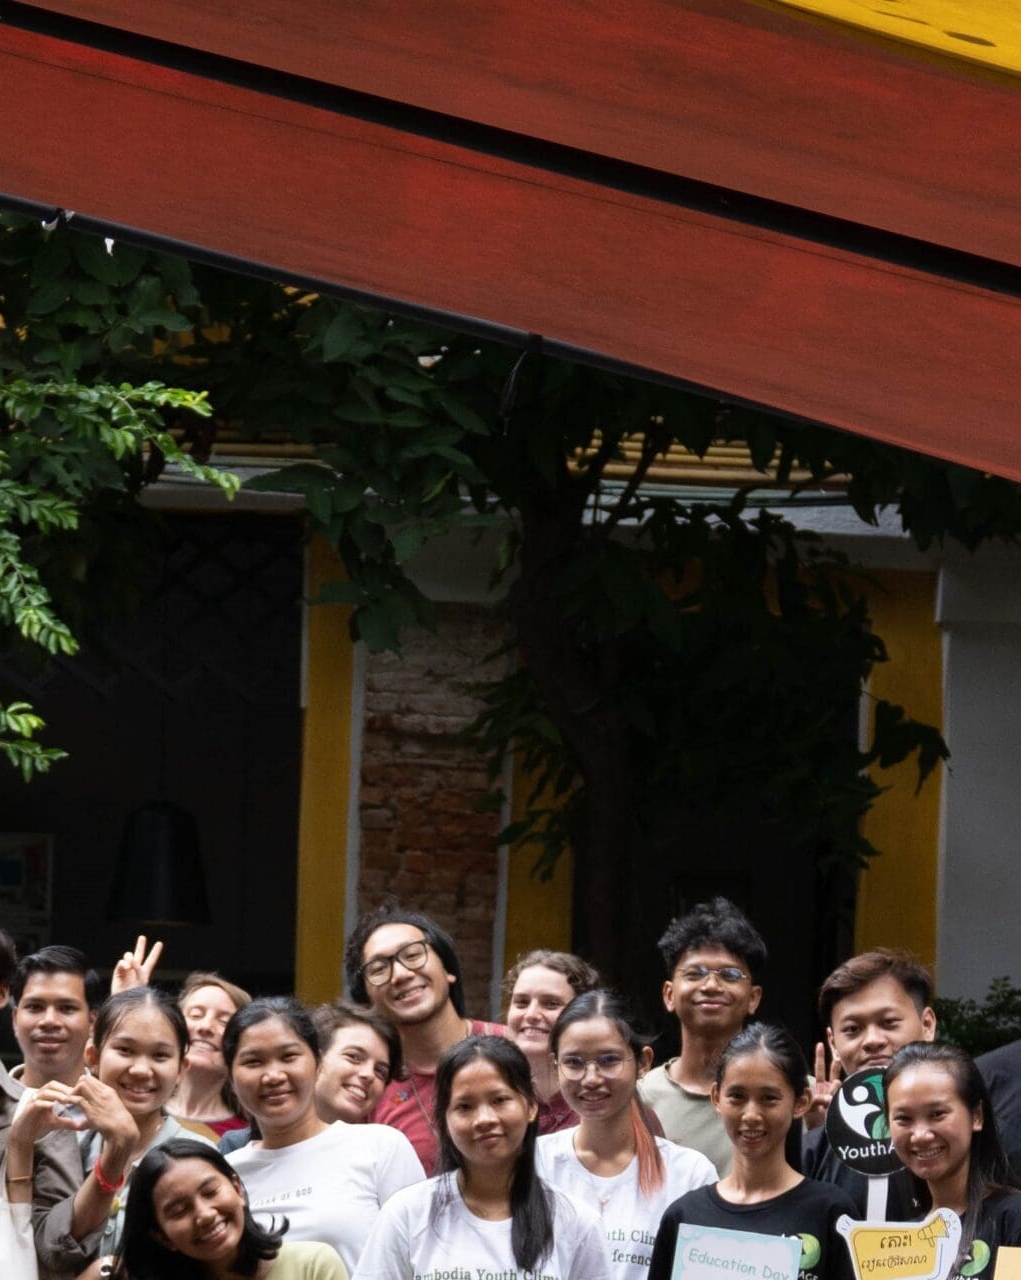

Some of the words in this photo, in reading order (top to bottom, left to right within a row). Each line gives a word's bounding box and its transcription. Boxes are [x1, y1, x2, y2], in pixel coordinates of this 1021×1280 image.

[296, 1186, 313, 1198] GOD
[611, 1248, 652, 1267] ferenc
[688, 1248, 757, 1276] Education
